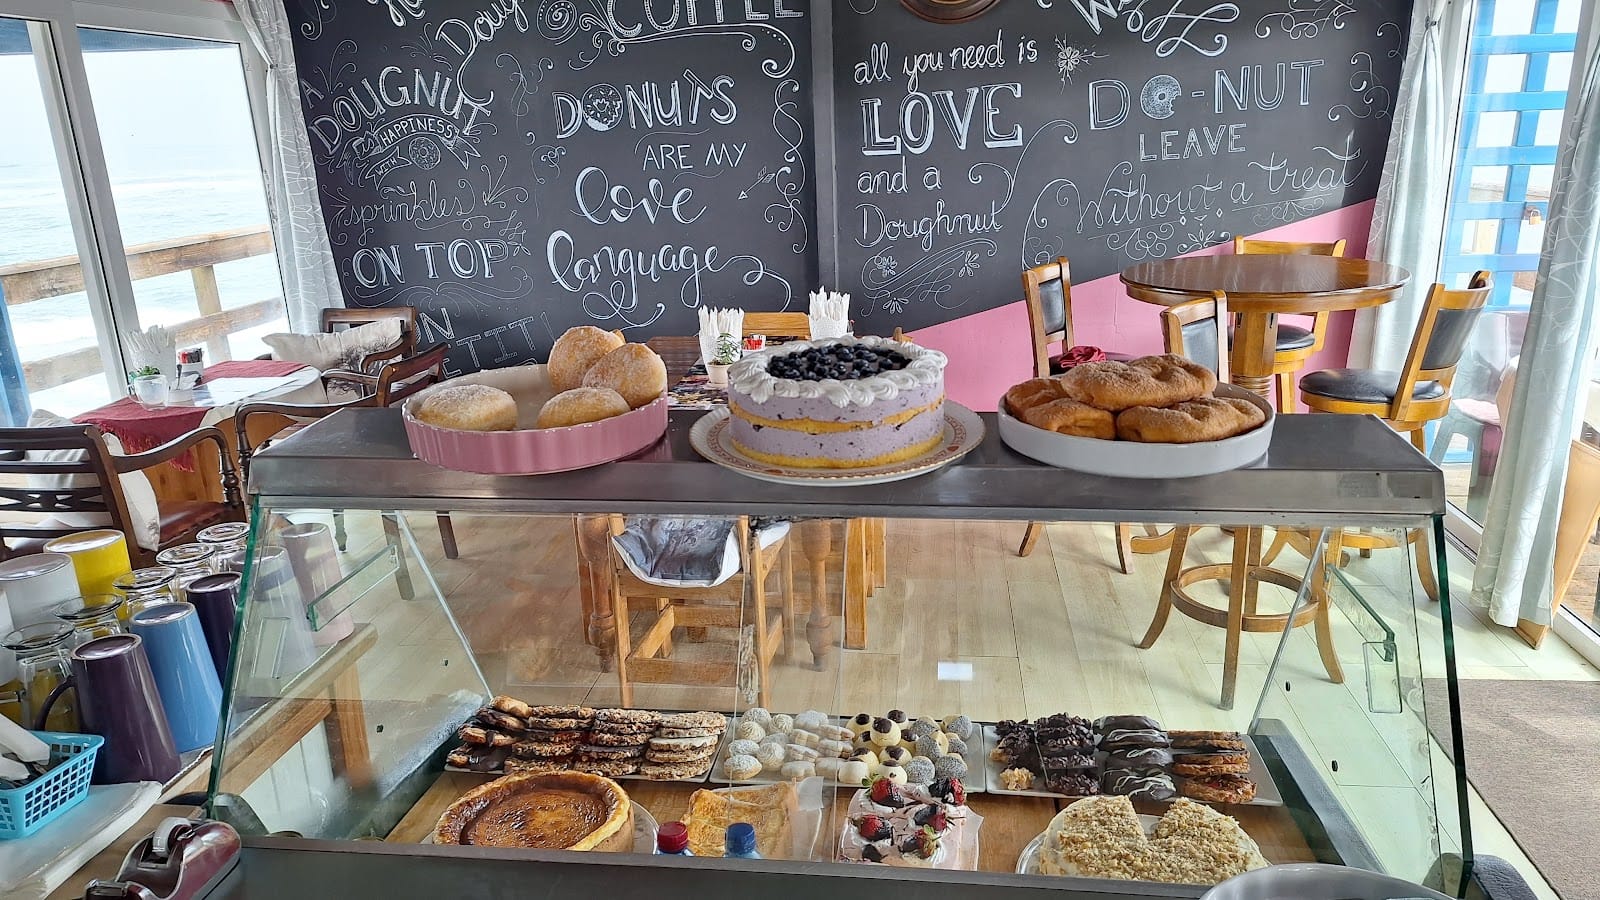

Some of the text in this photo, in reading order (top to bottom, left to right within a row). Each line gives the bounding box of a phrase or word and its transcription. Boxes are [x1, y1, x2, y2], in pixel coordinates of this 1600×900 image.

[854, 41, 891, 85] all
[902, 52, 944, 93] you
[950, 29, 1006, 69] need
[1018, 35, 1038, 64] is
[301, 79, 325, 108] A
[310, 66, 491, 155] DOUGNUT
[552, 69, 737, 138] DONUTS
[860, 82, 1023, 156] LOVE
[380, 117, 454, 147] HAPPINESS
[643, 142, 747, 170] ARE MY
[1138, 123, 1247, 162] LEAVE
[376, 157, 398, 177] WITH
[857, 156, 942, 193] and a
[1074, 129, 1368, 233] Without a treat
[344, 179, 474, 246] sprinkles
[570, 166, 707, 224] love
[855, 199, 1003, 251] Doughnut
[353, 239, 509, 288] ON TOP
[547, 230, 719, 309] language
